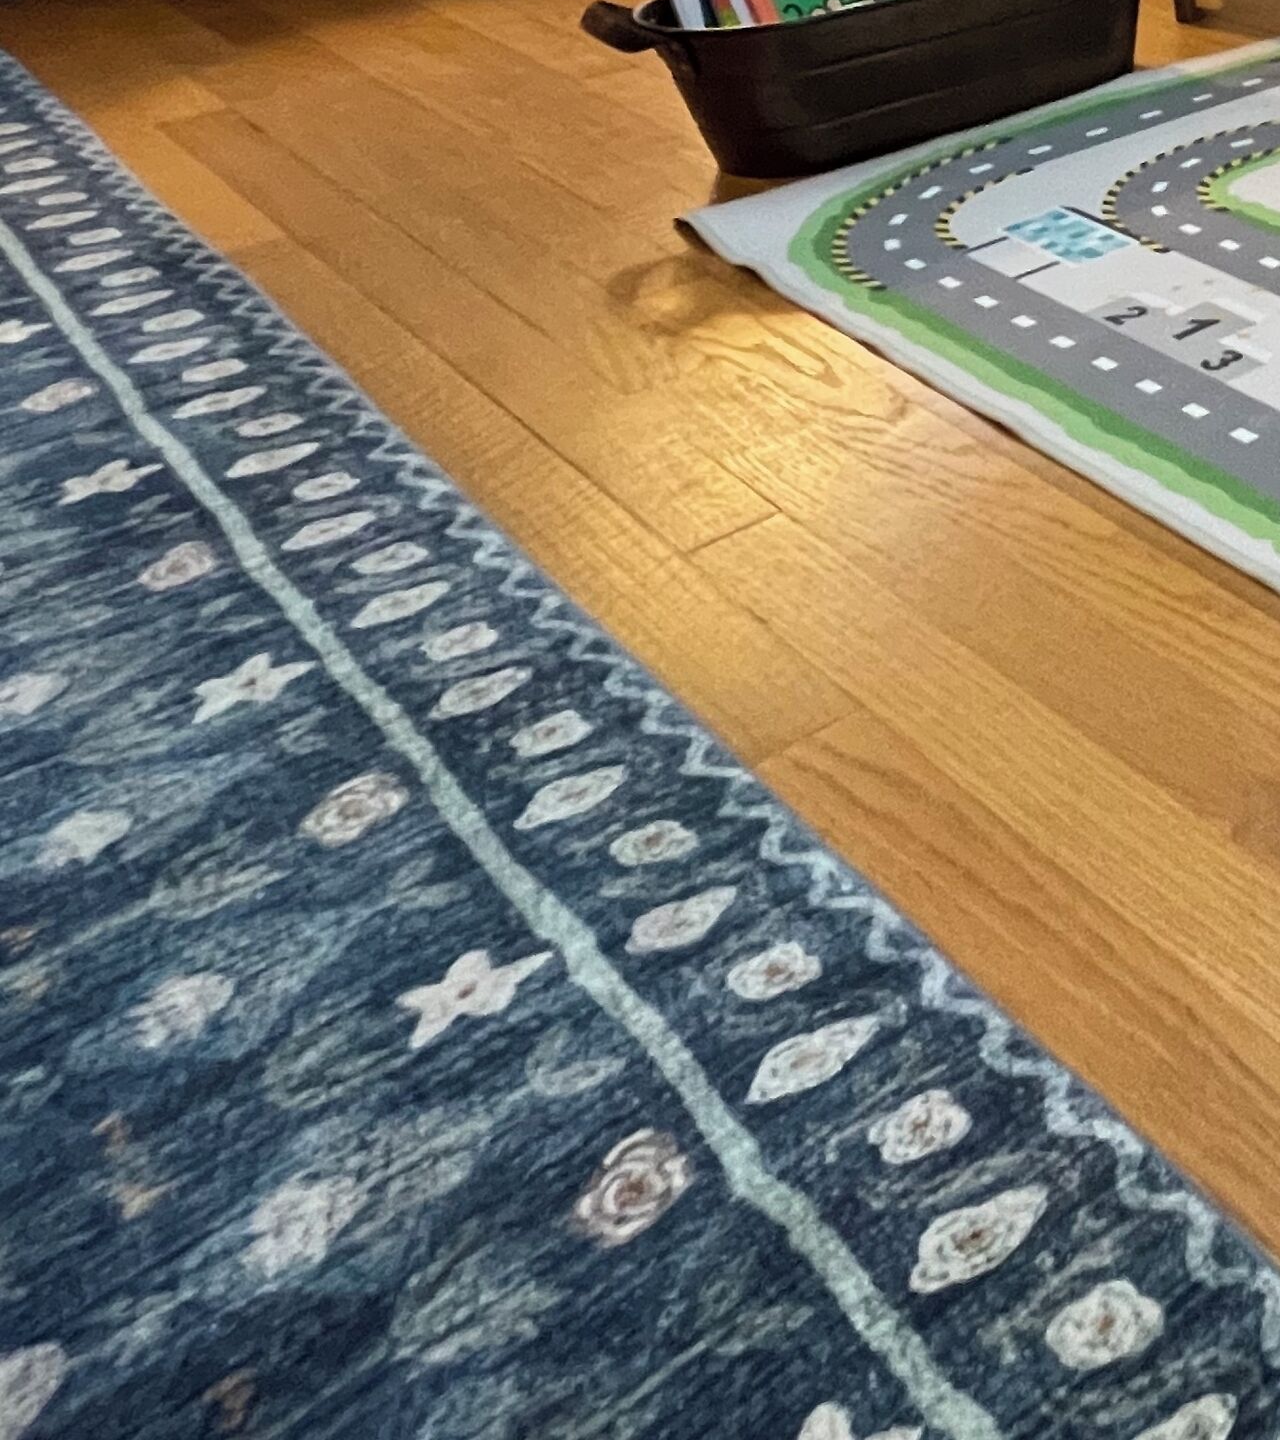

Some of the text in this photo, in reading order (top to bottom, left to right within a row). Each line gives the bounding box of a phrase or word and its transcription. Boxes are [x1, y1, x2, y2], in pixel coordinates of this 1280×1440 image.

[1103, 306, 1148, 325] 2
[1172, 319, 1220, 340] 1
[1201, 350, 1243, 371] 3
